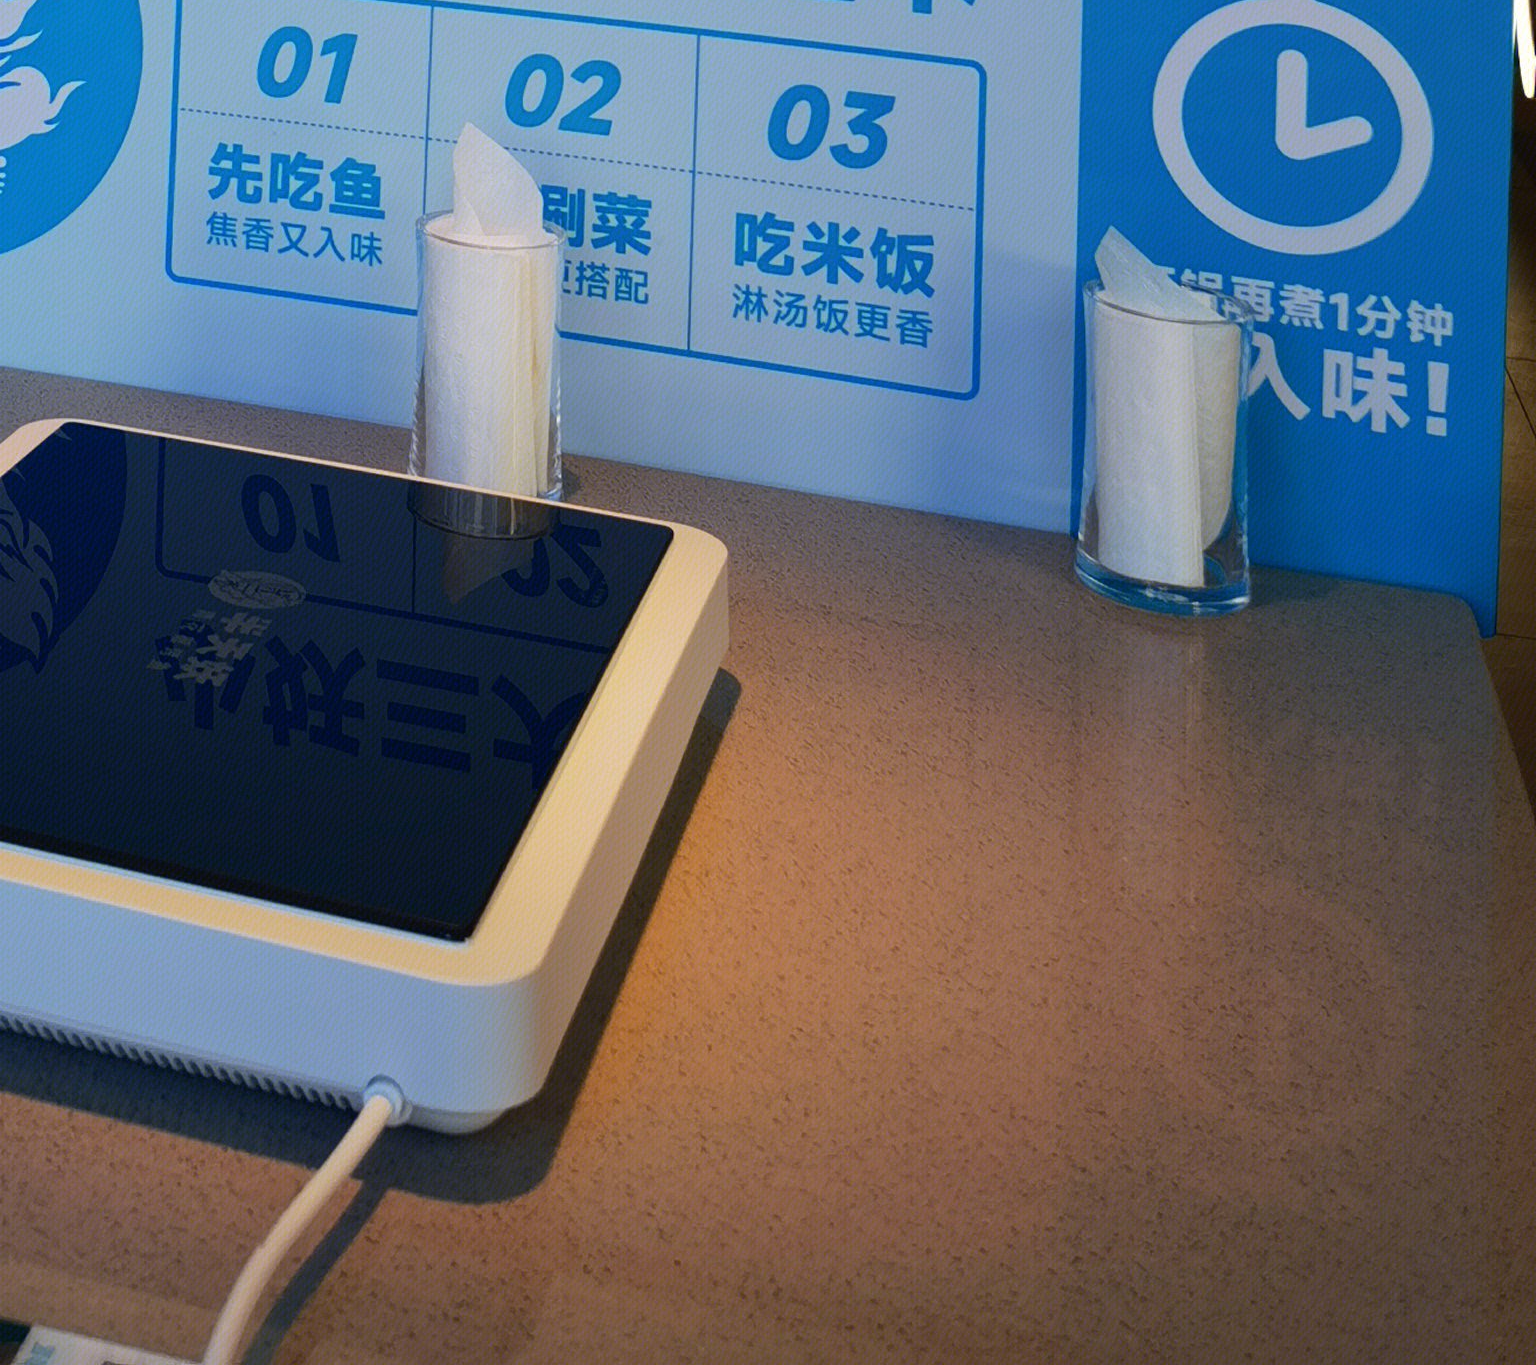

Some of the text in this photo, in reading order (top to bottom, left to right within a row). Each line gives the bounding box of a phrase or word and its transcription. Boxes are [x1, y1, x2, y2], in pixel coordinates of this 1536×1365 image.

[256, 25, 358, 105] 01
[504, 53, 622, 136] 02
[767, 84, 896, 170] 03
[207, 142, 386, 220] 先吃鱼
[205, 210, 384, 268] 焦香又入味
[733, 211, 936, 299] 吃米饭
[731, 283, 934, 349] 淋汤饭更香
[1247, 330, 1450, 438] 入味!
